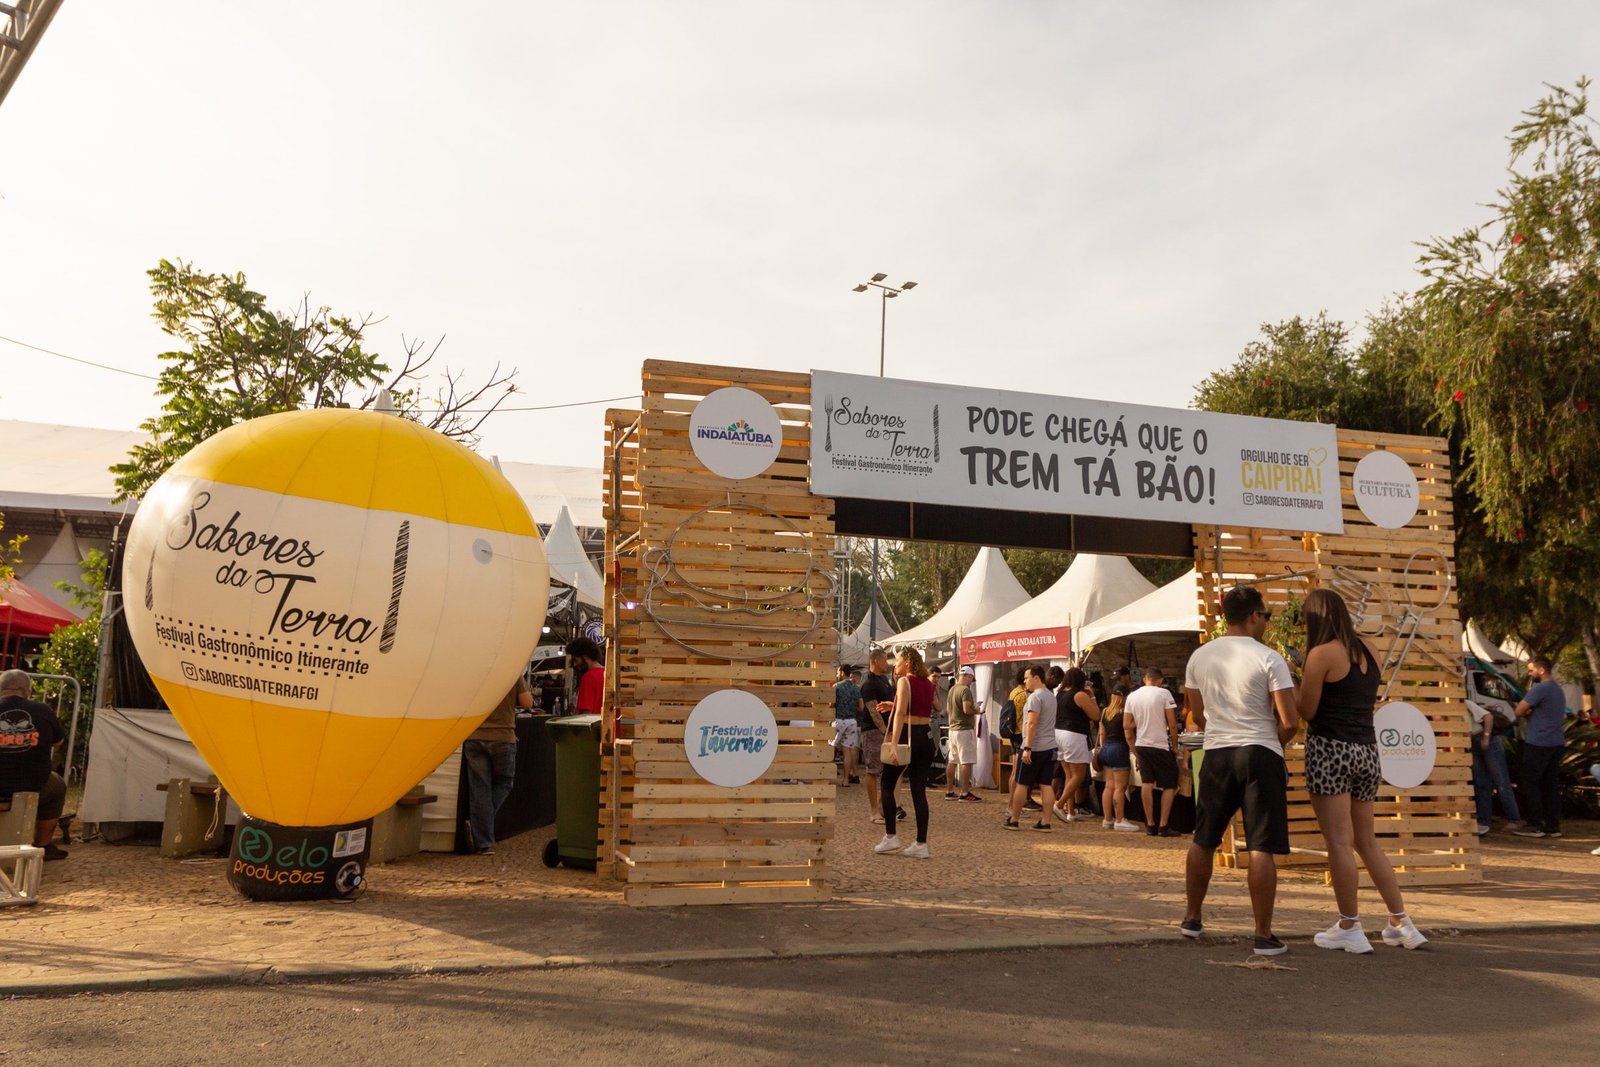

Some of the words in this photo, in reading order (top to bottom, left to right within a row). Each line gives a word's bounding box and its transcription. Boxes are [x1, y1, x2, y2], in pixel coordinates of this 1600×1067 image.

[834, 397, 906, 428] Sabores
[697, 429, 774, 444] INDAIATUBA
[865, 427, 882, 439] da
[883, 429, 933, 459] Terra
[966, 406, 1034, 437] PODE
[1045, 415, 1128, 447] CHEGÁ
[1138, 423, 1184, 454] QUE
[1193, 429, 1208, 455] O
[832, 457, 857, 467] Festival
[858, 459, 902, 471] Gastronômico
[902, 463, 933, 474] Itinerante
[1240, 448, 1279, 464] ORGULHO
[1280, 452, 1292, 465] DE
[1293, 454, 1309, 466] SER
[960, 446, 1059, 493] TREM
[1074, 449, 1121, 497] TÁ
[1135, 455, 1216, 505] BÃO!
[1241, 461, 1322, 495] CAIPIRA!
[1255, 495, 1324, 510] SABORESDATERRAFGI
[1360, 485, 1412, 498] CULTURA
[166, 491, 324, 567] Sabores
[216, 560, 251, 587] da
[255, 569, 378, 644] Terra
[156, 622, 194, 646] Festival
[198, 632, 292, 664] Gastronômico
[297, 651, 369, 675] Itinerante
[981, 640, 1006, 650] BUDDHA
[1006, 639, 1017, 647] SPA
[1017, 635, 1056, 646] INDAIATUBA
[198, 667, 319, 700] SABORESDATERRAFGI
[698, 726, 768, 757] Inverno
[711, 725, 753, 736] Festival
[755, 726, 768, 736] de
[1402, 730, 1425, 746] elo
[275, 838, 329, 868] elo
[233, 860, 325, 885] produções
